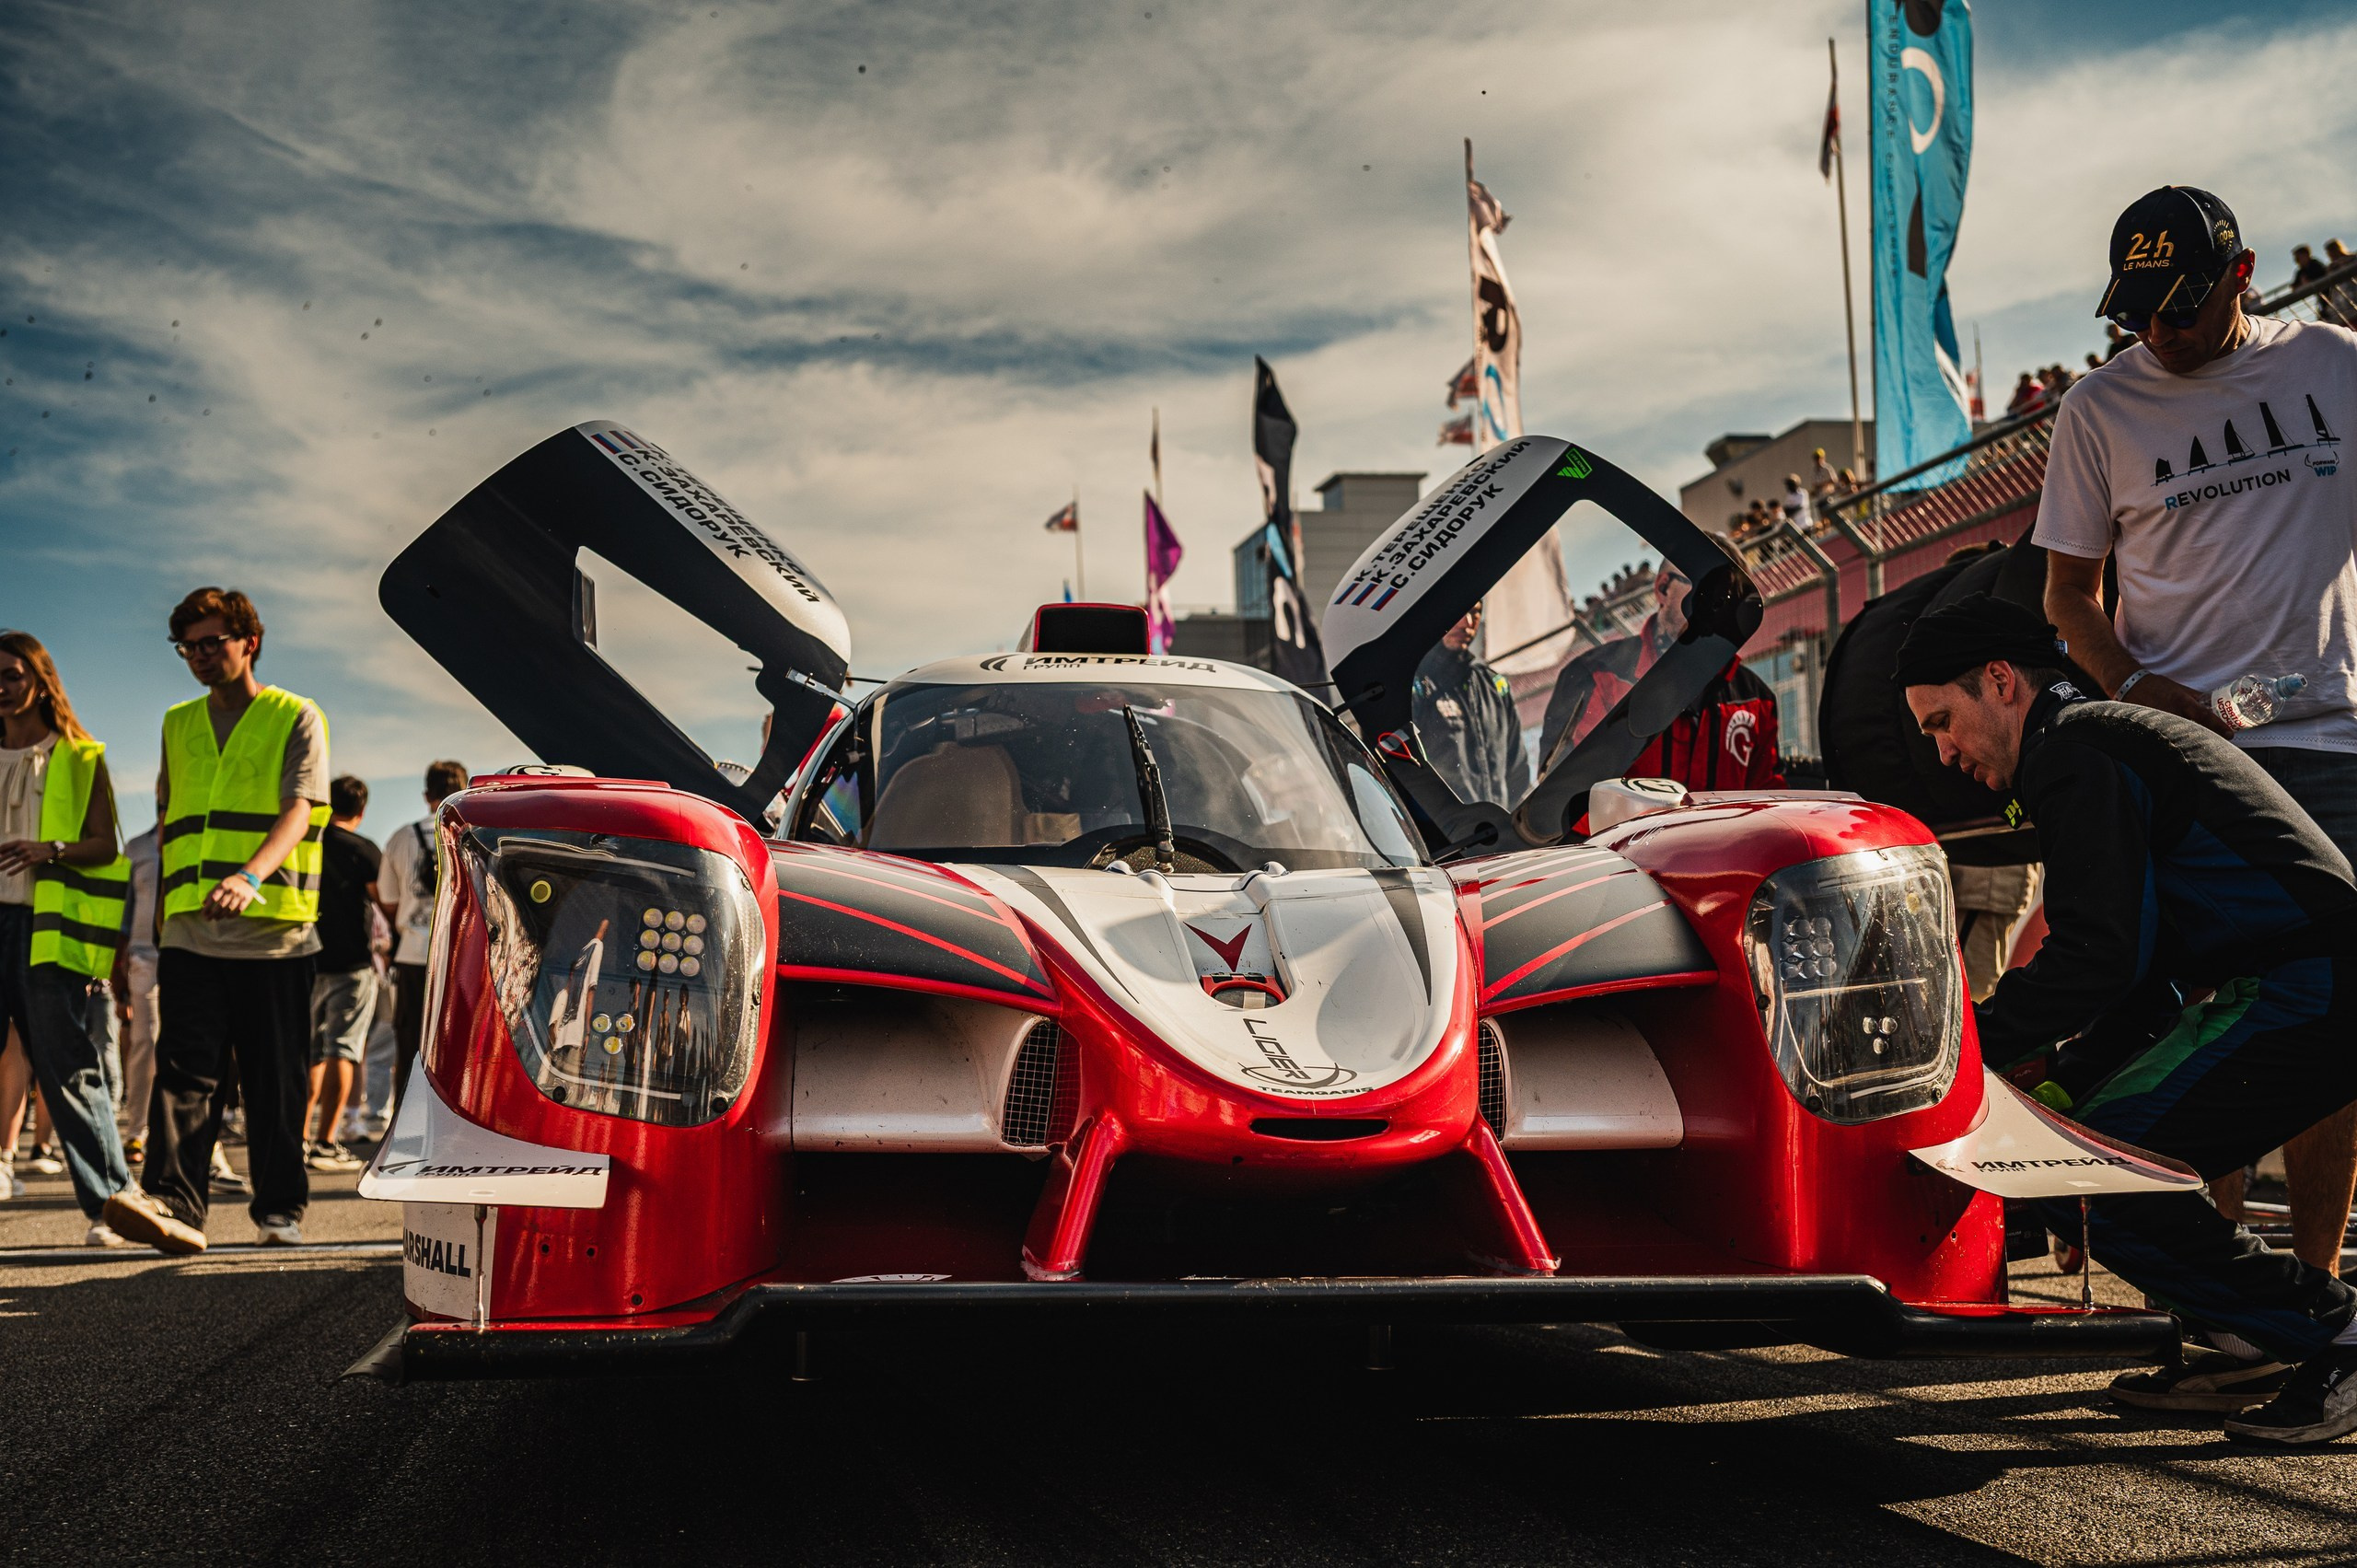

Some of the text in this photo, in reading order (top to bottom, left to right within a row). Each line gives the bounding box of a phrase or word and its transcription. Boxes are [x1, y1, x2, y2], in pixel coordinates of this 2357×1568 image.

[2123, 259, 2170, 271] LE MANS
[2314, 465, 2337, 477] WIP
[2165, 469, 2292, 510] REVOLUTION
[618, 453, 752, 559] С.СИДОРУК
[1390, 482, 1504, 589] С.СИДОРУК
[419, 1164, 603, 1176] ИМТРЕЙД
[1970, 1156, 2133, 1169] ИМТРЕЙД
[403, 1226, 471, 1278] ARSHALL
